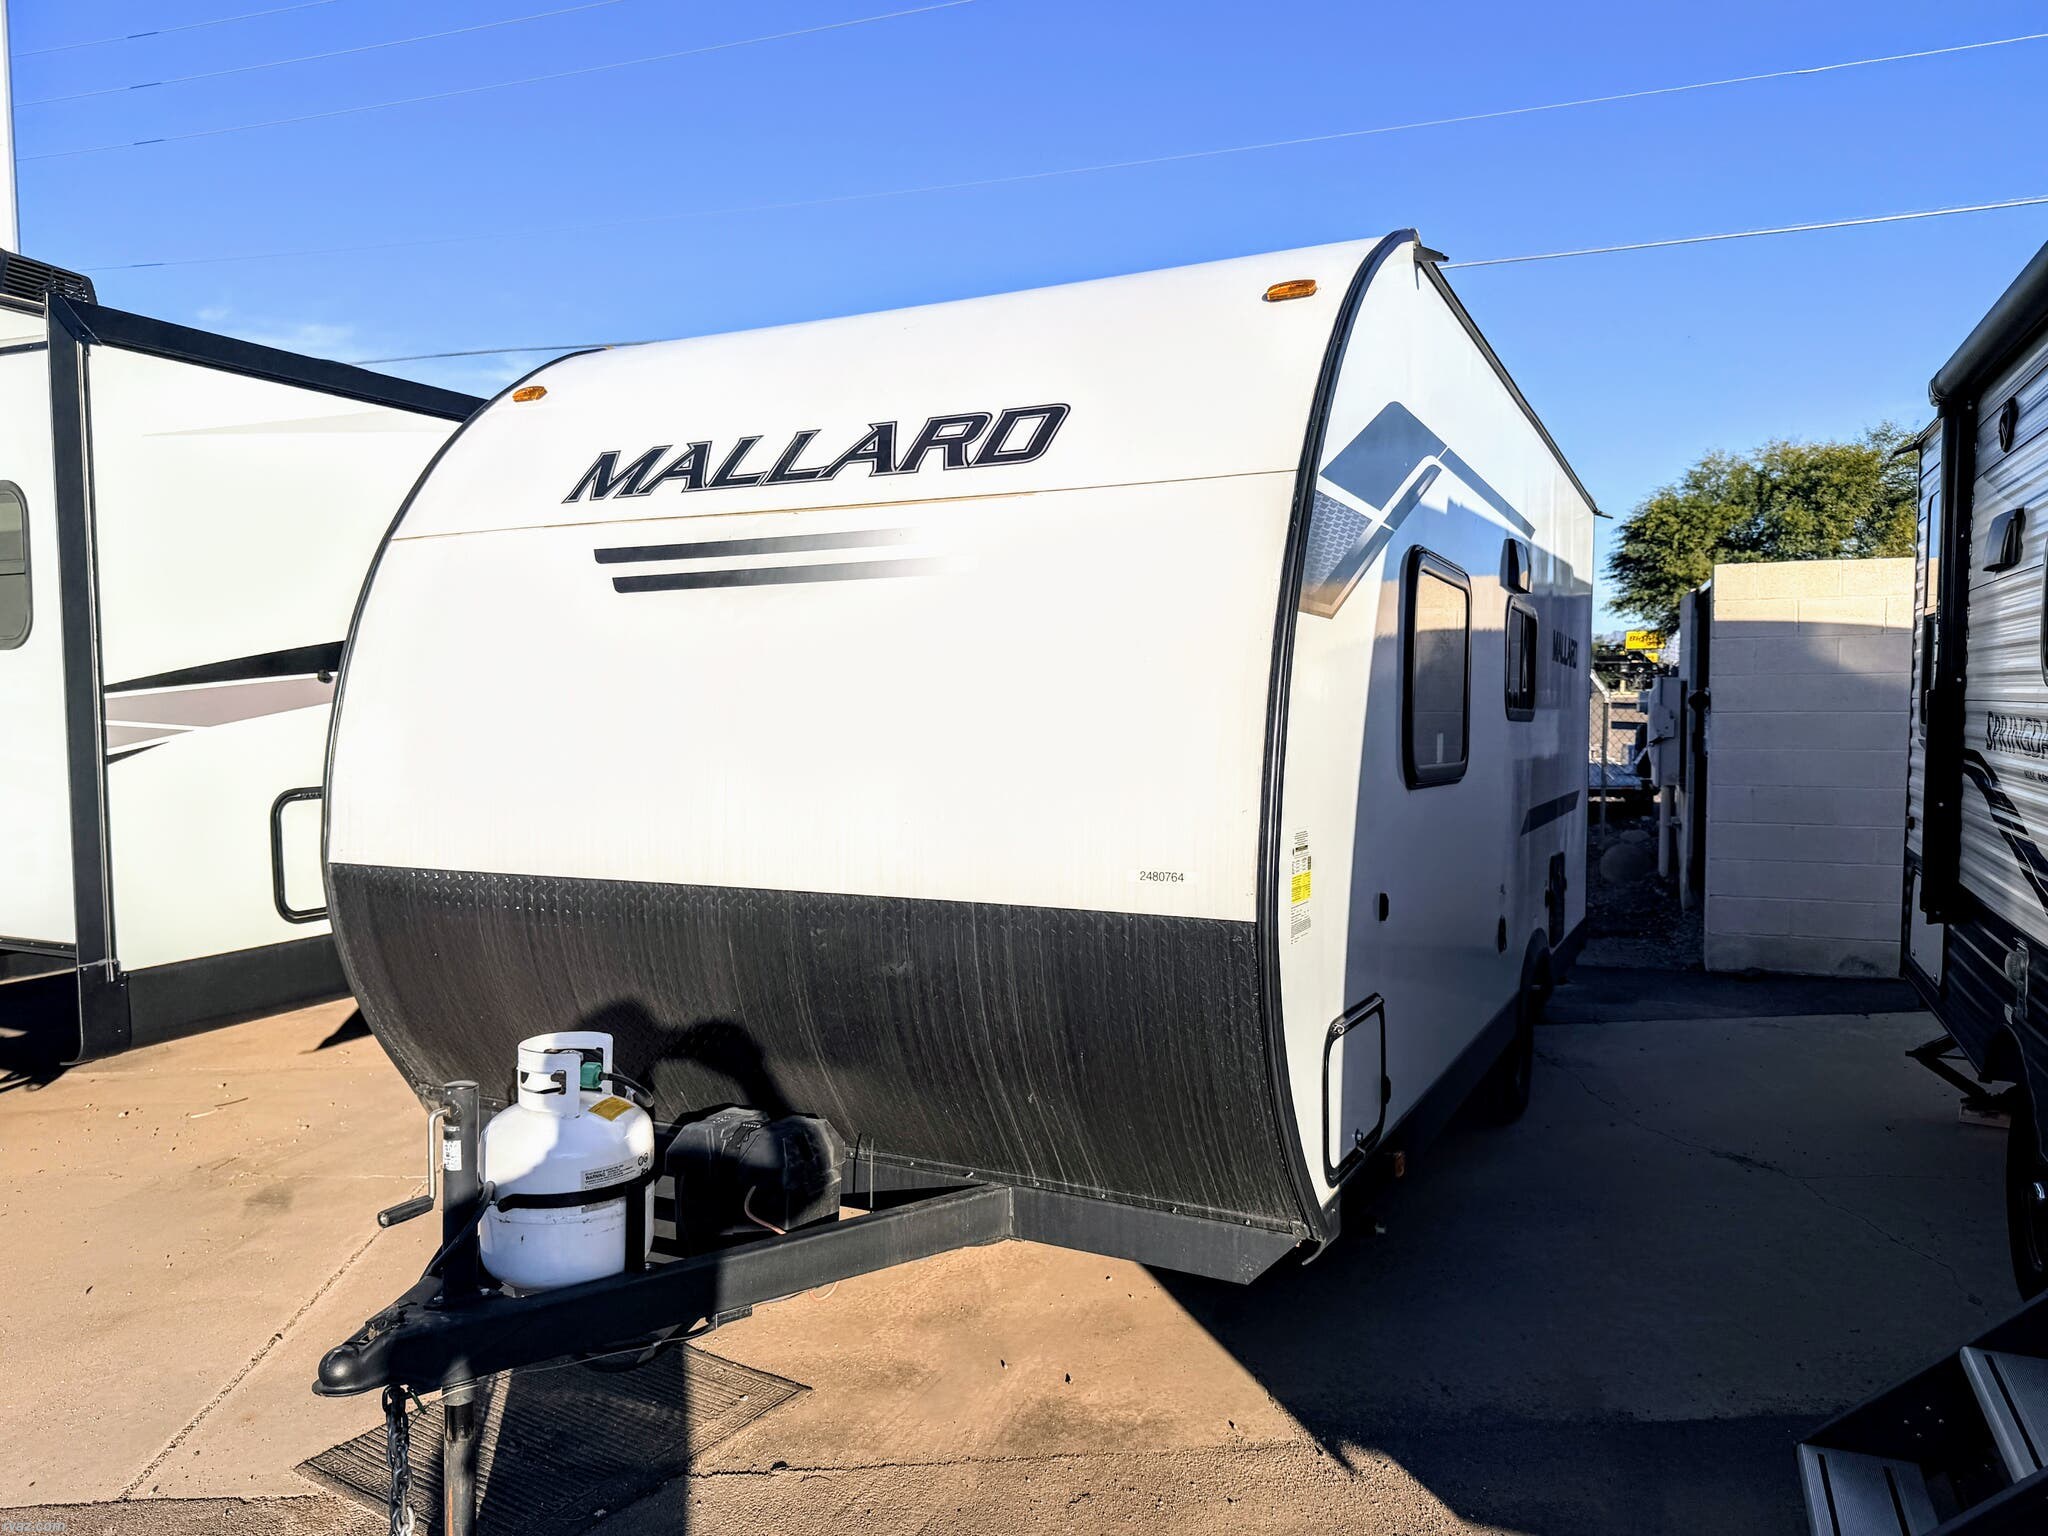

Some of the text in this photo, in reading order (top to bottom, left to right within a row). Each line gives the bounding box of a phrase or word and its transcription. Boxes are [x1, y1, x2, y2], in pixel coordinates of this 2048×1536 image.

[562, 402, 1071, 504] MALLARD
[1552, 630, 1578, 669] MALLARD
[1139, 870, 1185, 883] 2480764
